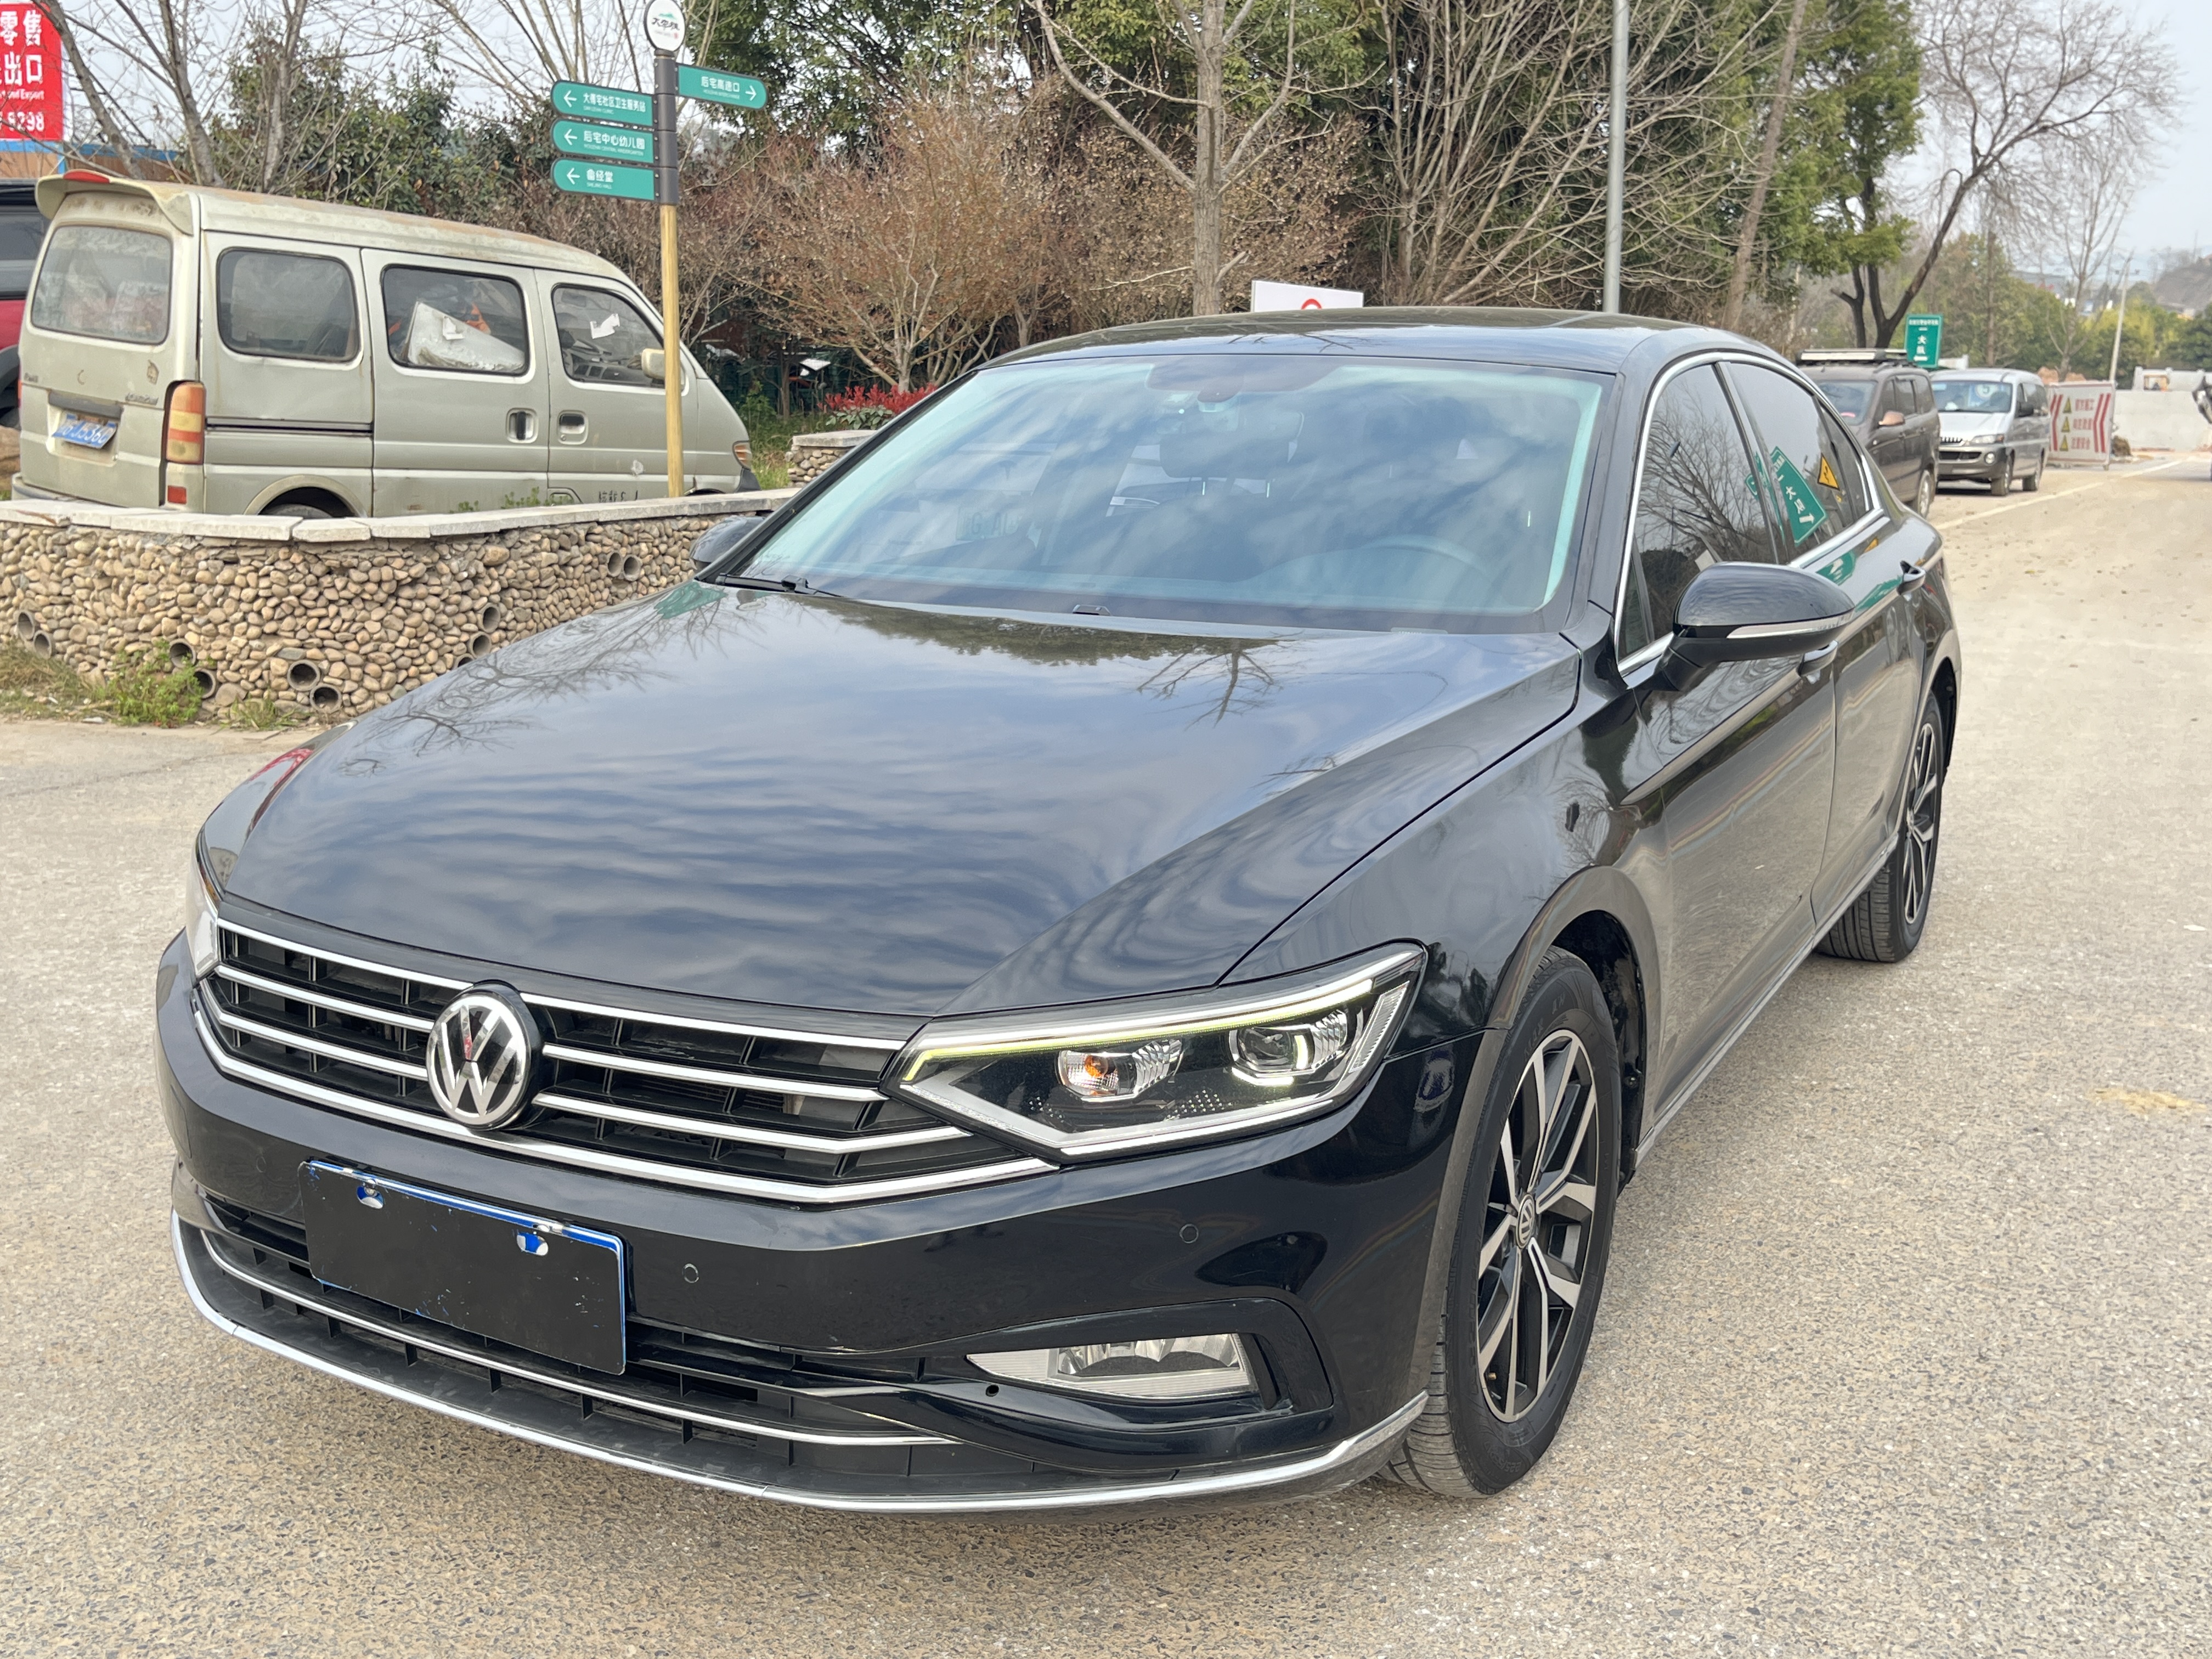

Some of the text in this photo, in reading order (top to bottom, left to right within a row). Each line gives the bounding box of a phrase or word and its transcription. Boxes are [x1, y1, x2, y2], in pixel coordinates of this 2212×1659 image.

[0, 10, 42, 46] 零售
[0, 52, 42, 86] 出口
[0, 111, 44, 131] 9298
[584, 131, 645, 150] 后宅中心幼儿园
